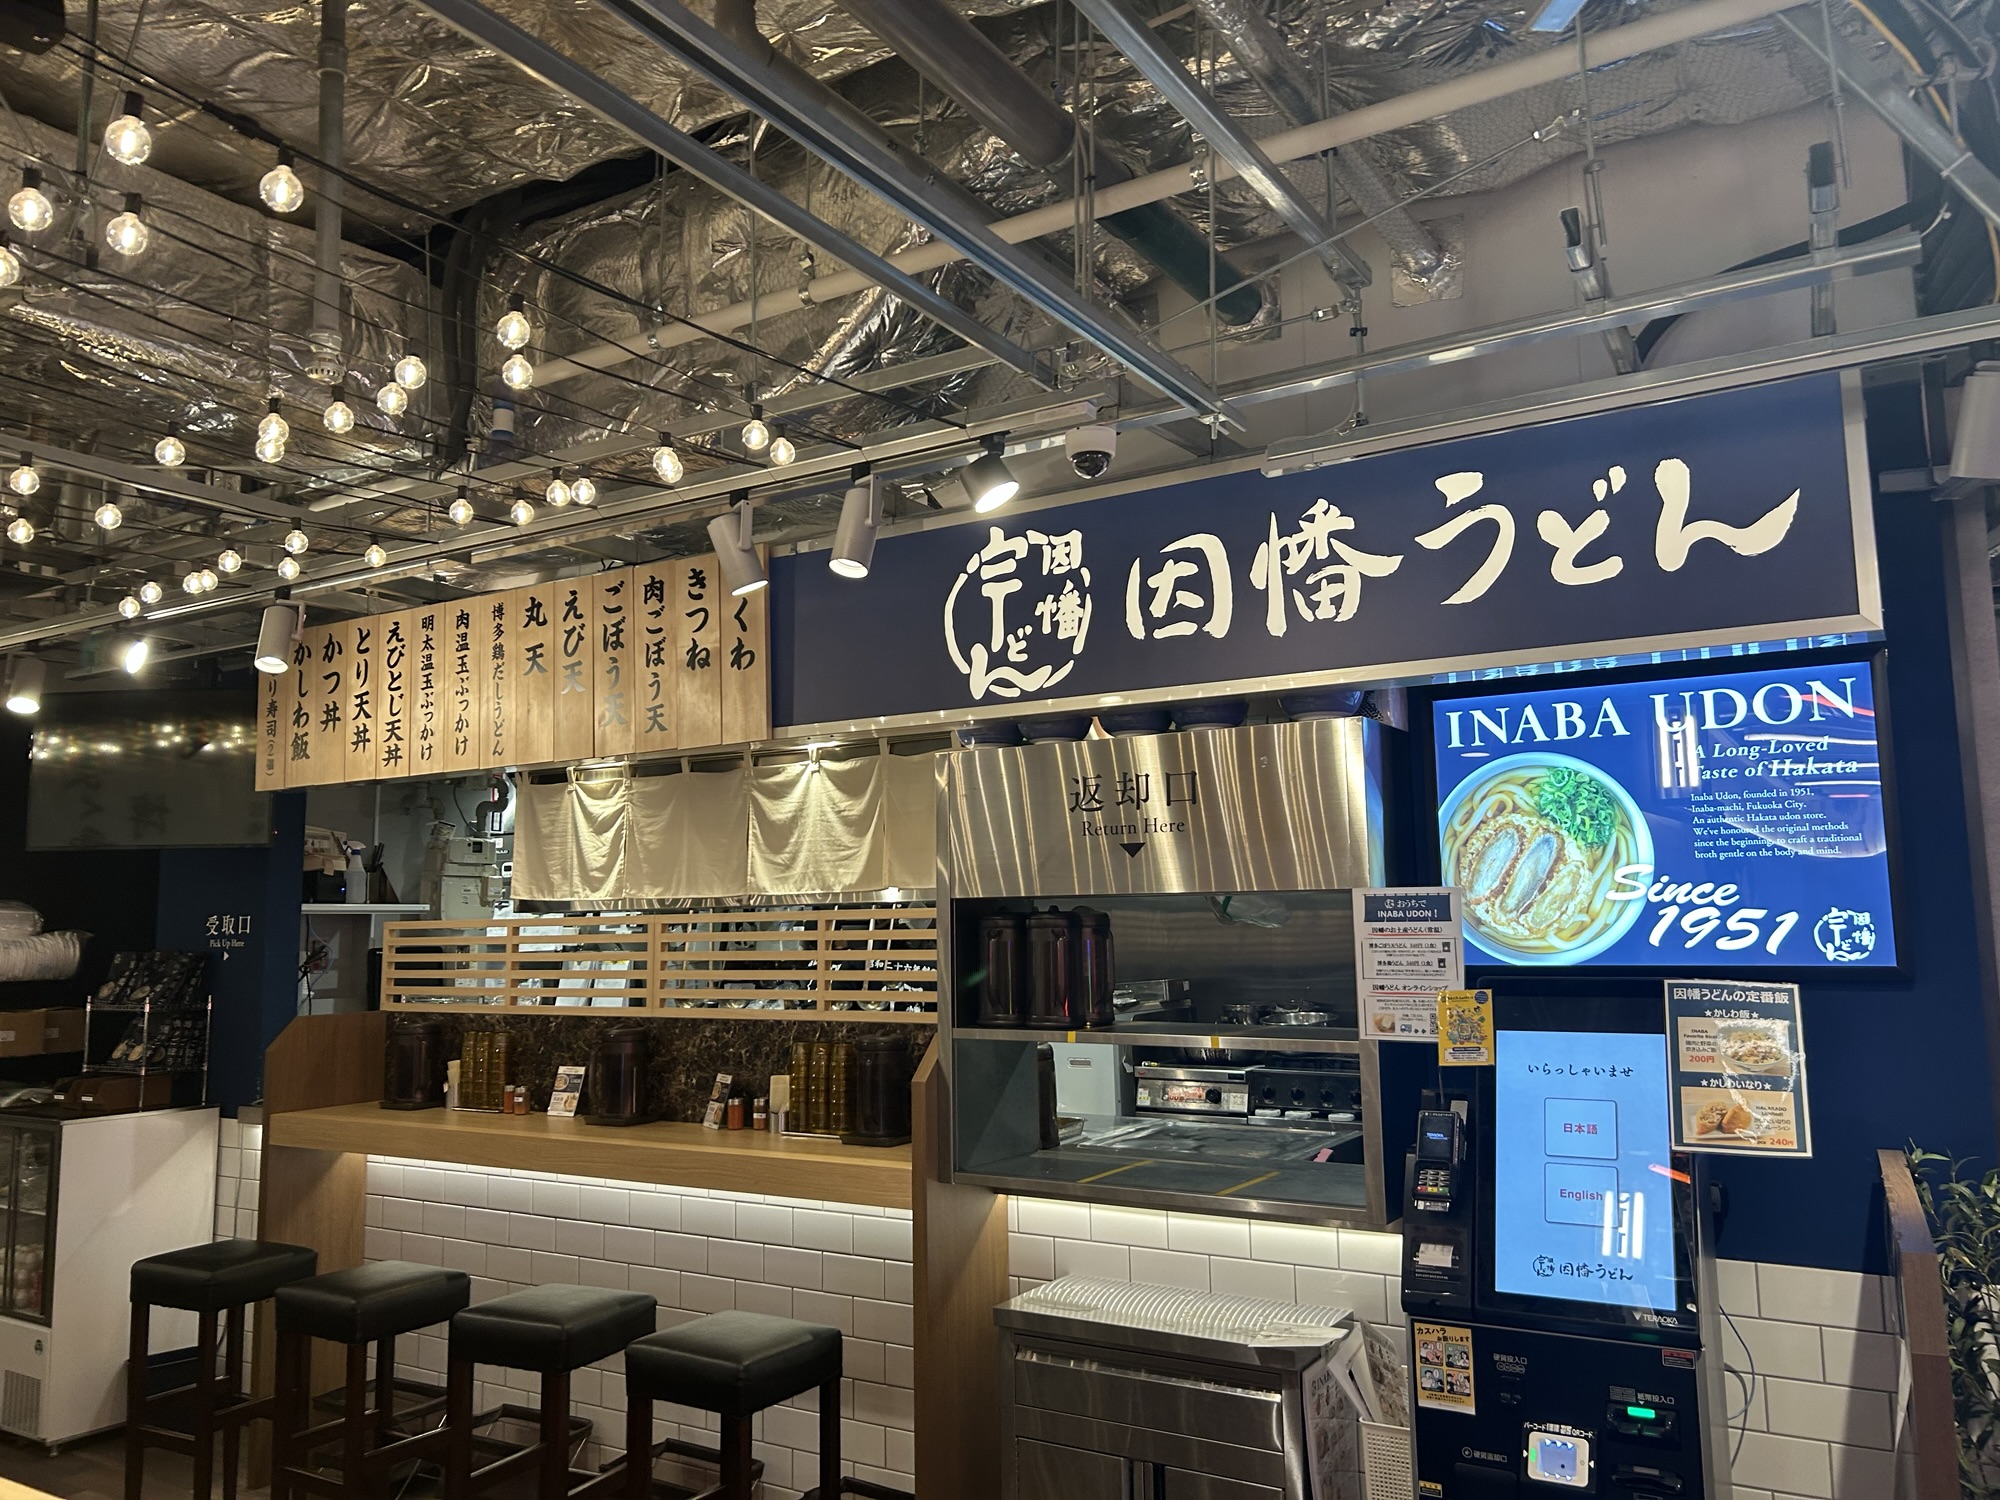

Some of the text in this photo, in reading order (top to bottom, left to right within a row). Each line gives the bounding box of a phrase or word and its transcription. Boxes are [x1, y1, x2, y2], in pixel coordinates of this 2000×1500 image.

[1126, 457, 1800, 640] 因幡うどん
[685, 567, 711, 671] きつね
[522, 596, 549, 677] 丸天
[560, 589, 586, 695] えび天
[730, 597, 756, 671] くわ
[600, 580, 628, 728] ごぼう天
[643, 575, 668, 734] 肉ごぼう天
[320, 633, 343, 733] かつ丼
[350, 627, 372, 753] とり天丼
[420, 614, 436, 761] 明太温玉ぶっかけ
[454, 608, 471, 756] 肉温玉ぶっかけ
[491, 602, 506, 757] 博多鶏だしうどん
[290, 642, 312, 761] かしわ飯
[381, 621, 406, 768] えびとじ天丼
[1445, 677, 1857, 750] INABA UDON
[265, 673, 278, 776] り寿司（2）
[1694, 736, 1829, 760] A Long-Loved
[1696, 756, 1859, 781] Taste of Hakata
[1069, 770, 1198, 813] 返却口
[1690, 787, 1814, 802] Inaba Udon, founded in 1951,
[1691, 800, 1807, 814] Inaba-machi, Fukuoka City.
[1692, 811, 1827, 824] An authentic Hakata udon store.
[1082, 817, 1185, 837] Return Here
[1693, 827, 1719, 836] We've
[1761, 824, 1775, 833] the
[1776, 823, 1810, 834] original
[1811, 822, 1849, 831] methods
[1693, 838, 1714, 847] since
[1715, 837, 1730, 846] the
[1776, 836, 1786, 844] to
[1787, 834, 1808, 844] craft
[1816, 833, 1862, 843] traditional
[1694, 850, 1717, 859] broth
[1718, 849, 1744, 860] gentle
[1759, 848, 1774, 857] the
[1774, 847, 1796, 859] body
[1797, 846, 1815, 855] and
[1815, 846, 1842, 855] mind.
[1605, 863, 1740, 906] Since
[1377, 910, 1404, 918] INABA
[1397, 899, 1427, 908] おうちで
[206, 914, 251, 936] 受取口
[1648, 904, 1799, 955] 1951
[209, 938, 245, 950] Pick Up Here
[1401, 984, 1449, 992] オンラインショップ
[1673, 987, 1790, 1005] 因幡うどんの定番飯
[1689, 1055, 1715, 1063] 200円
[1527, 1063, 1634, 1078] いらっしゃいませ
[1563, 1123, 1598, 1135] 日本語
[1769, 1137, 1794, 1146] 240円
[1559, 1188, 1603, 1201] English
[1559, 1262, 1634, 1281] 因幡うどん
[1642, 1313, 1679, 1325] TERAOKA
[1416, 1327, 1447, 1335] カスハラ
[1437, 1335, 1470, 1343] お断りします
[1523, 1421, 1547, 1432] バーコード
